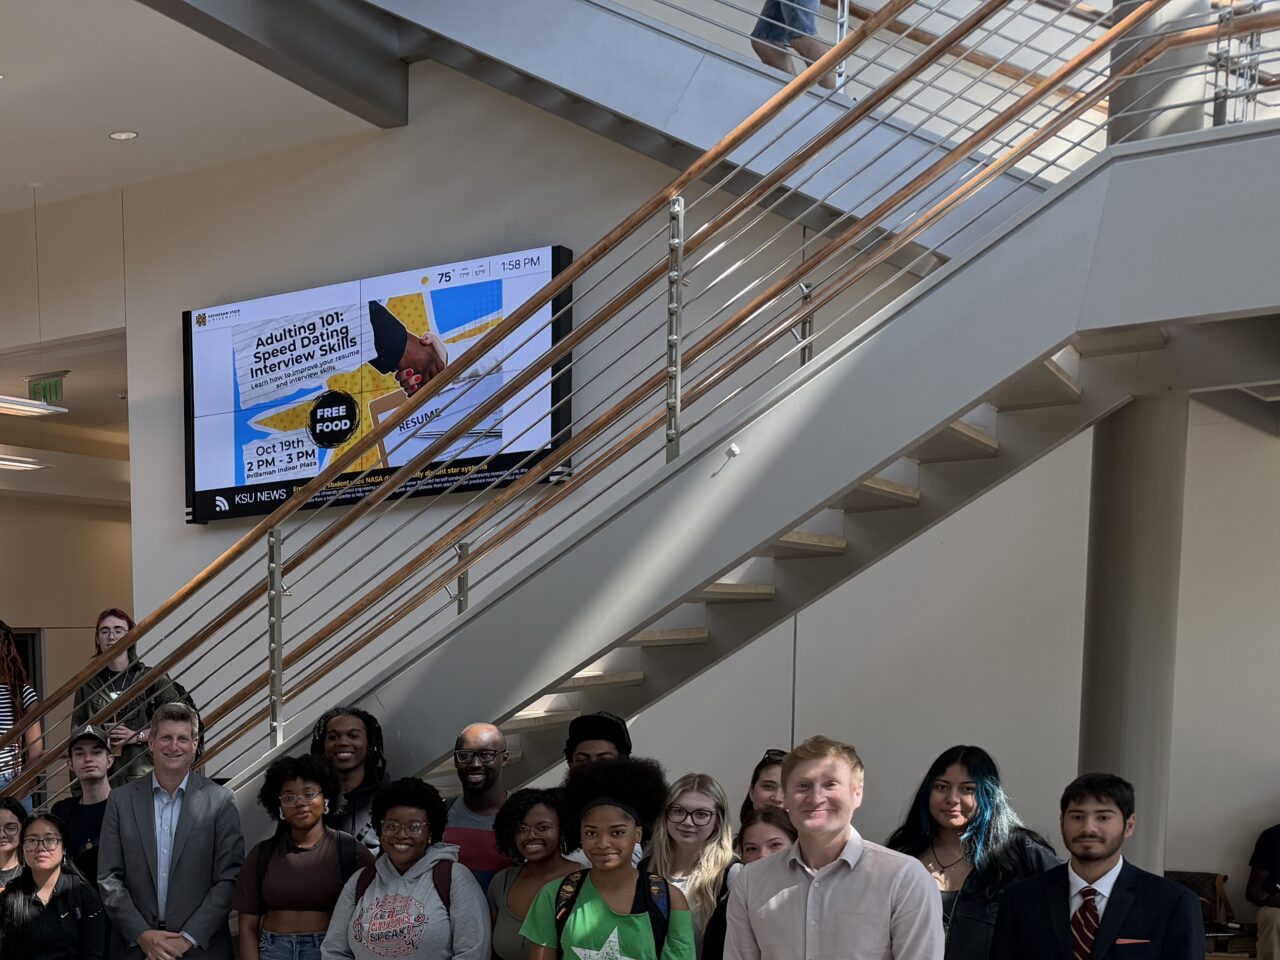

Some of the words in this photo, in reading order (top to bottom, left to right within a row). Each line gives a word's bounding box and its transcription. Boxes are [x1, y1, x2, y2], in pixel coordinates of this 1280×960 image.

[501, 260, 521, 272] 1:58
[523, 256, 540, 269] PM
[255, 321, 316, 349] Adulting
[319, 312, 345, 329] 101:
[253, 341, 297, 364] Speed
[301, 325, 350, 349] Dating
[250, 351, 315, 379] Interview
[320, 336, 358, 357] Skills
[251, 378, 269, 390] Learn
[269, 375, 283, 385] how
[283, 372, 292, 380] to
[292, 363, 319, 378] improve
[318, 359, 335, 370] your
[335, 350, 360, 362] resume
[275, 379, 289, 389] and
[289, 371, 319, 384] interview
[320, 364, 336, 375] skills
[33, 380, 60, 403] EXIT
[316, 405, 347, 419] FREE
[398, 408, 442, 432] RESUME
[316, 419, 351, 434] FOOD
[256, 443, 277, 456] Oct
[279, 438, 304, 451] 19th
[246, 469, 276, 480] Prillaman
[277, 464, 298, 473] Indoor
[300, 460, 317, 470] Plaza
[247, 461, 254, 471] 2
[257, 457, 276, 469] PM
[286, 453, 293, 464] 3
[297, 449, 316, 461] PM
[365, 475, 383, 484] NASA
[235, 493, 255, 505] KSU
[257, 488, 287, 502] NEWS
